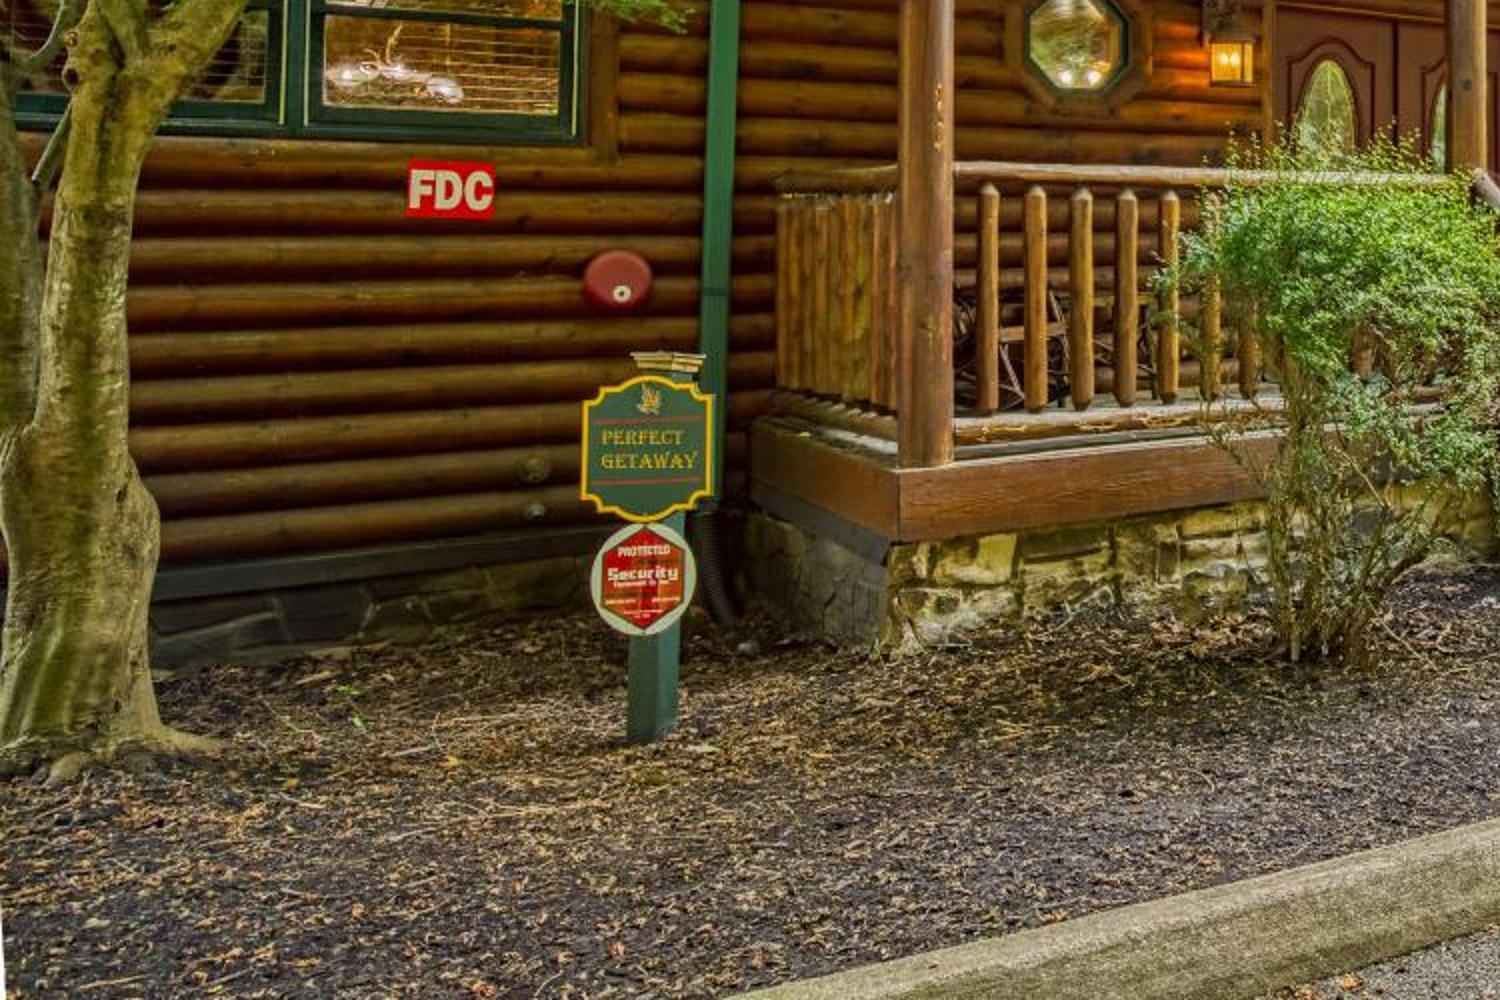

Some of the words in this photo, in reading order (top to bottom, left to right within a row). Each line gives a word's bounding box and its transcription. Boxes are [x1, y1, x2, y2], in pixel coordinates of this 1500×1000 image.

[409, 169, 493, 211] FDC
[602, 429, 684, 445] PERFECT
[601, 451, 697, 469] GETAWAY
[607, 565, 679, 581] Security
